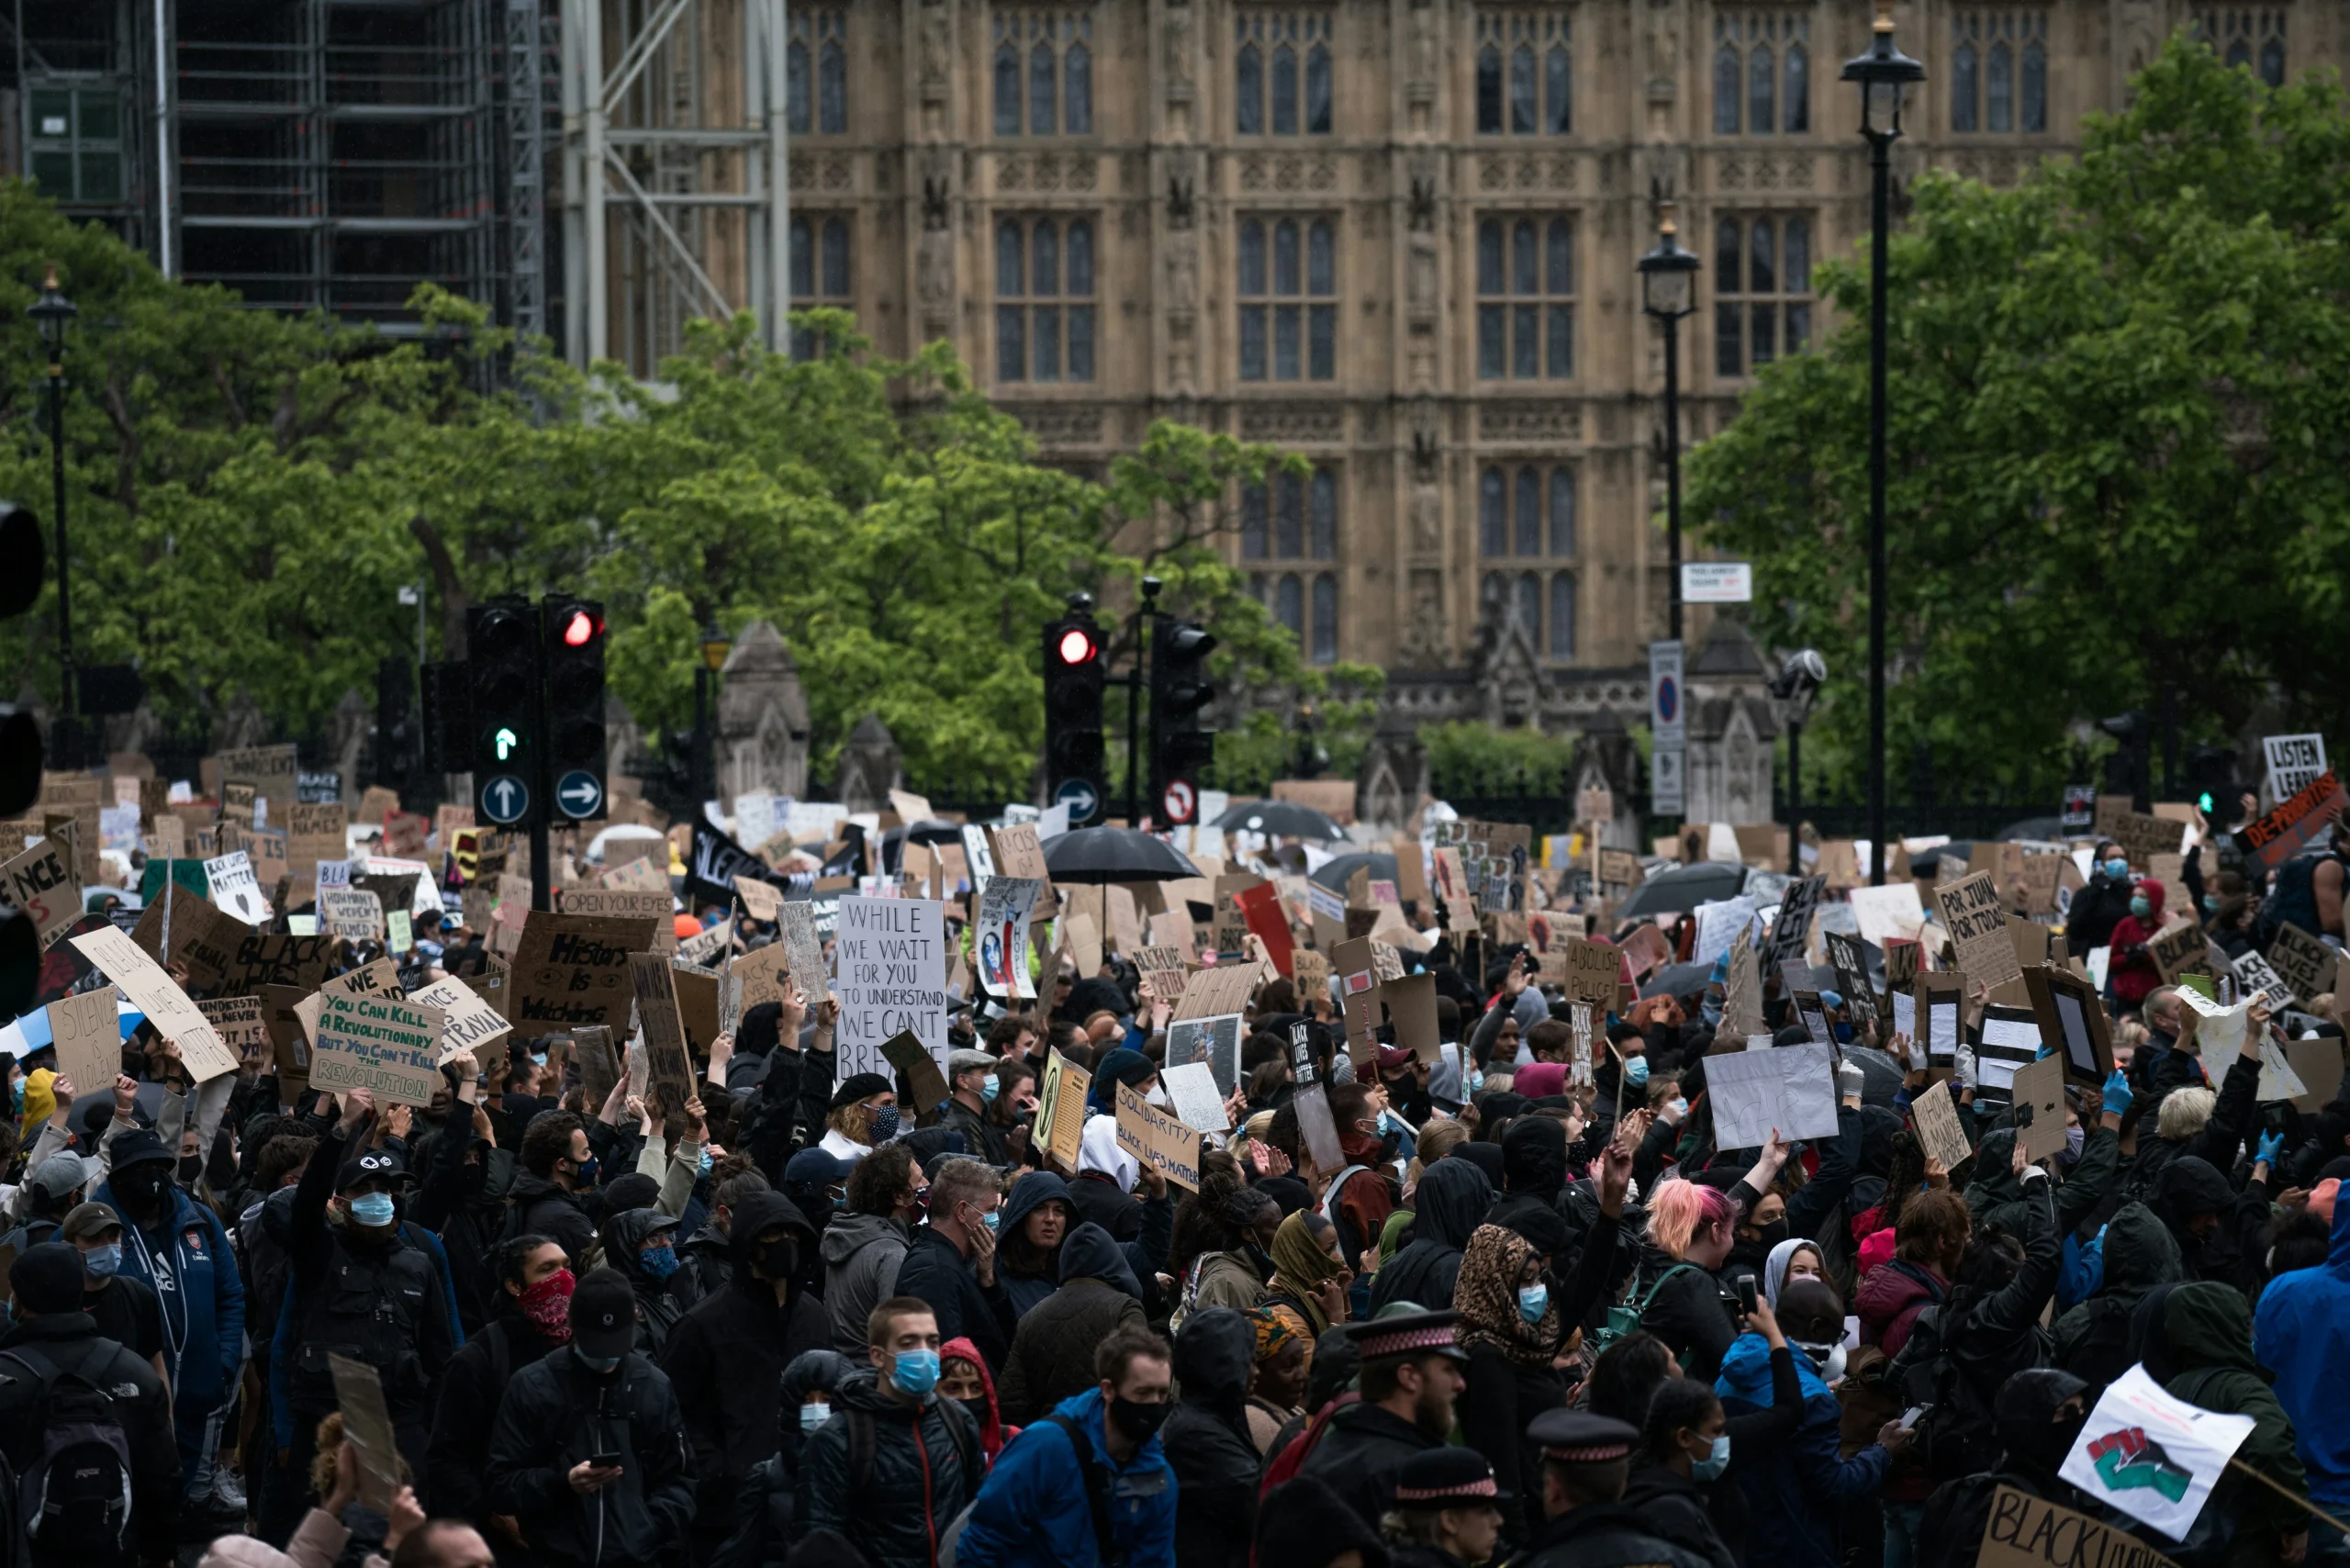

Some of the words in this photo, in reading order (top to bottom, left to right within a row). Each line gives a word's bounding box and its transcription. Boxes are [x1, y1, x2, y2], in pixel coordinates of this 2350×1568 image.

[2270, 739, 2320, 768] LISTEN
[207, 858, 226, 876] BLACK
[212, 869, 255, 894] MATTER
[565, 895, 604, 913] OPEN
[609, 895, 639, 912] YOUR
[643, 896, 672, 913] EYES
[1941, 890, 1968, 919] POR
[1964, 875, 1998, 909] JUAN
[848, 903, 922, 934] WHILE
[1950, 916, 1976, 946] POR
[1972, 905, 2007, 935] TODOS
[94, 937, 156, 977] BLACK
[181, 938, 229, 979] EQUAL
[237, 935, 329, 964] BLACK
[843, 939, 869, 960] WE
[878, 939, 931, 961] WAIT
[1132, 946, 1159, 972] BLACK
[1160, 946, 1185, 971] LIVES
[1571, 944, 1620, 974] ABOLISH
[2272, 945, 2318, 982] LIVES
[343, 968, 378, 994] WE
[855, 964, 880, 985] FOR
[886, 964, 917, 985] YOU
[1149, 971, 1187, 997] MATTER
[140, 986, 190, 1014] LIVES
[198, 1000, 262, 1014] UNDERSTA
[326, 994, 354, 1014] YOU
[358, 1000, 387, 1021] CAN
[390, 1006, 428, 1029] KILL
[842, 988, 860, 1005] TO
[62, 992, 118, 1041] SILENCE
[222, 1011, 257, 1025] NEVER
[842, 1011, 877, 1039] WE
[1571, 1004, 1592, 1034] BLACK
[175, 1026, 231, 1066] MATTER
[319, 1014, 331, 1029] A
[333, 1014, 434, 1050] REVOLUTIONARY
[439, 1008, 509, 1058] ETRAYAL
[1291, 1024, 1309, 1047] BLACK
[92, 1039, 102, 1060] IS
[317, 1034, 343, 1051] BUT
[342, 1038, 370, 1055] YOU
[370, 1041, 410, 1063] CAN'T
[409, 1050, 436, 1071] KILL
[358, 1057, 381, 1067] THE
[1294, 1042, 1309, 1061] LIVES
[1573, 1033, 1592, 1062] LIVES
[70, 1049, 121, 1094] VIOLENCE
[317, 1058, 428, 1099] REVOLUTION
[1295, 1063, 1315, 1084] MATTER
[1118, 1089, 1192, 1145] SOLIDARITY
[1721, 1085, 1800, 1148] ACAB
[1923, 1087, 1951, 1125] HOW
[1930, 1116, 1957, 1152] MANY
[1117, 1122, 1142, 1154] BLACK
[1145, 1144, 1167, 1169] LIVES
[1168, 1160, 1199, 1186] MATTER
[1990, 1492, 2099, 1568] BLACK
